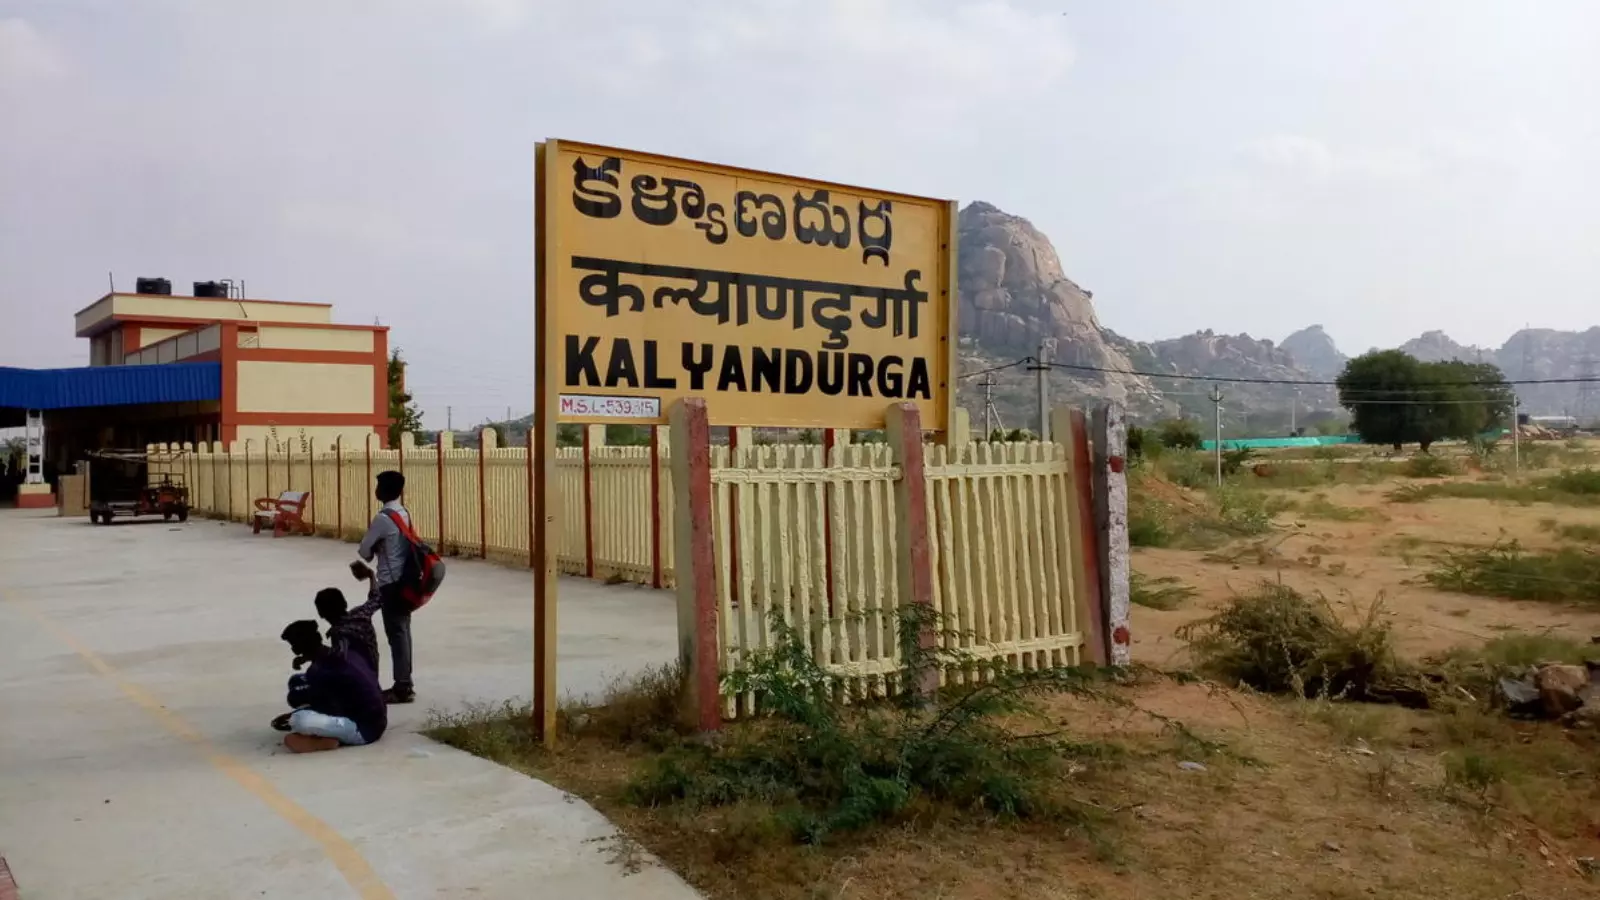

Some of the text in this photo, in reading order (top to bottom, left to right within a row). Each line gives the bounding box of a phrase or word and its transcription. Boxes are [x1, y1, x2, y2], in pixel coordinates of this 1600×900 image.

[572, 155, 893, 267] కళ్యాణదుర్గ
[571, 255, 928, 350] कल्याणदुर्गा
[565, 334, 932, 400] KALYANDURGA
